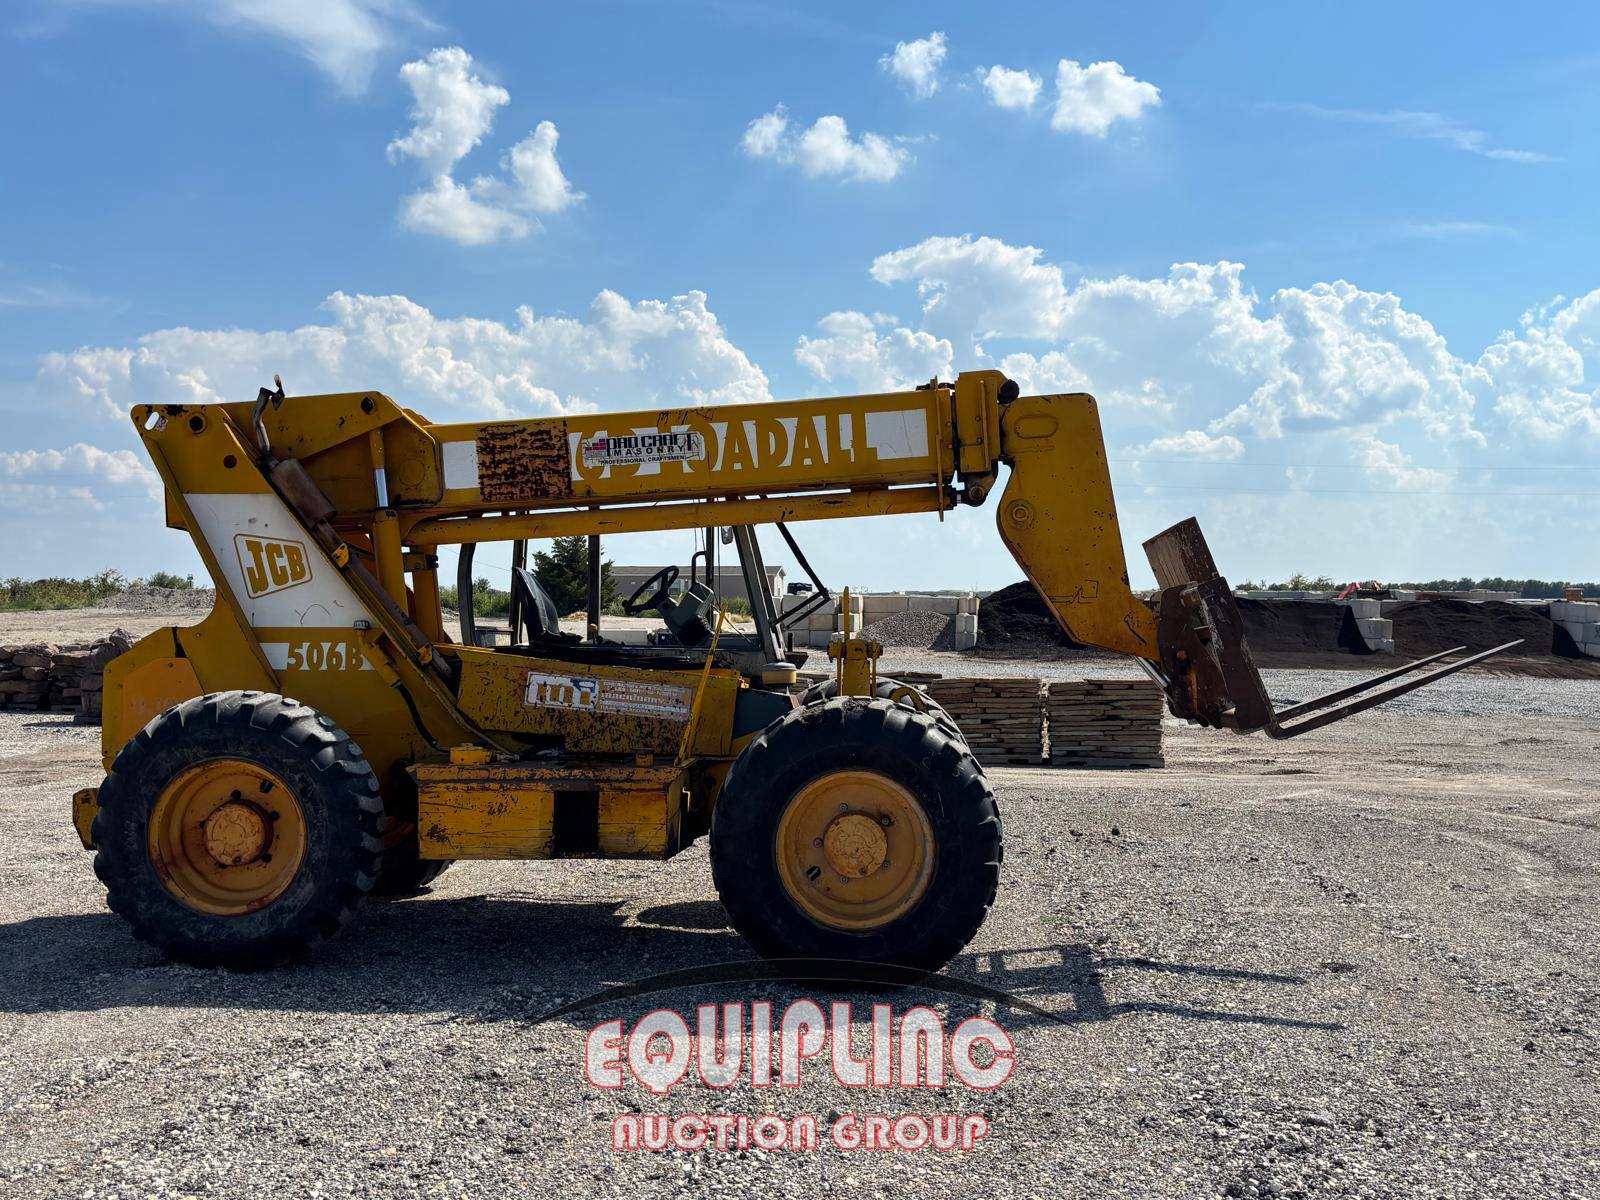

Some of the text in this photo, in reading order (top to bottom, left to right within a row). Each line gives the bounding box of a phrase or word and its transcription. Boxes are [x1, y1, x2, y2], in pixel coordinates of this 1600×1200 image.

[614, 445, 685, 457] MASONRY
[245, 539, 307, 594] JCB
[288, 642, 364, 671] 506B
